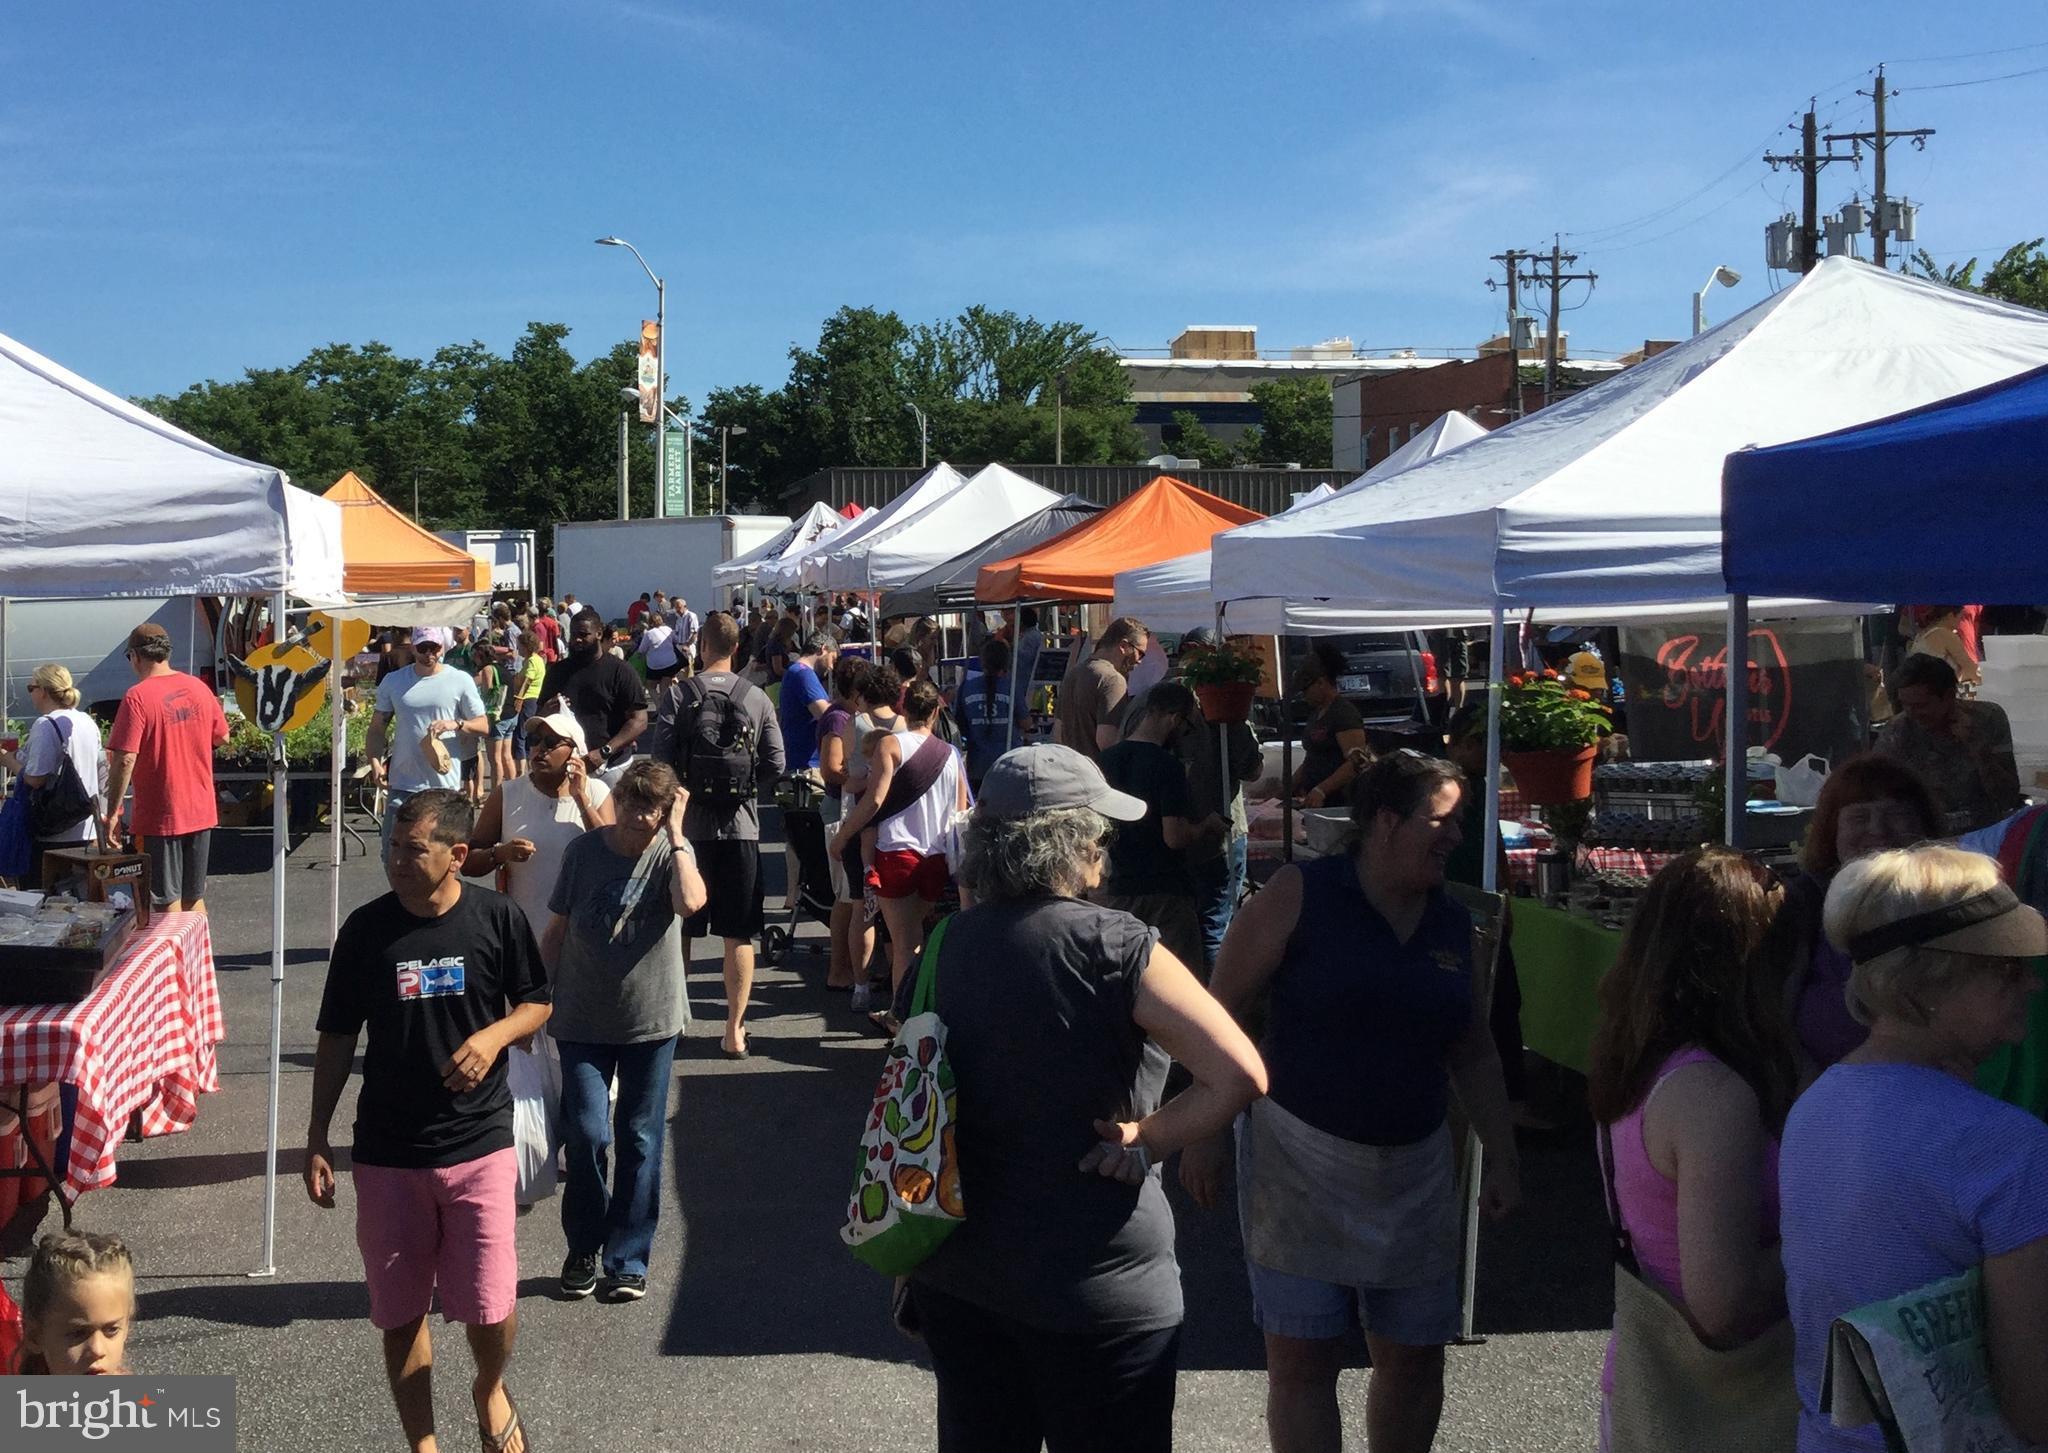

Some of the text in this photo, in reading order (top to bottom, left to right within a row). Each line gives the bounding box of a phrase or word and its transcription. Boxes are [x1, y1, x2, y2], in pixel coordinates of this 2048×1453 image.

[114, 863, 142, 876] DONUT
[396, 956, 465, 972] PELAGIC
[1897, 1288, 1976, 1353] GREE
